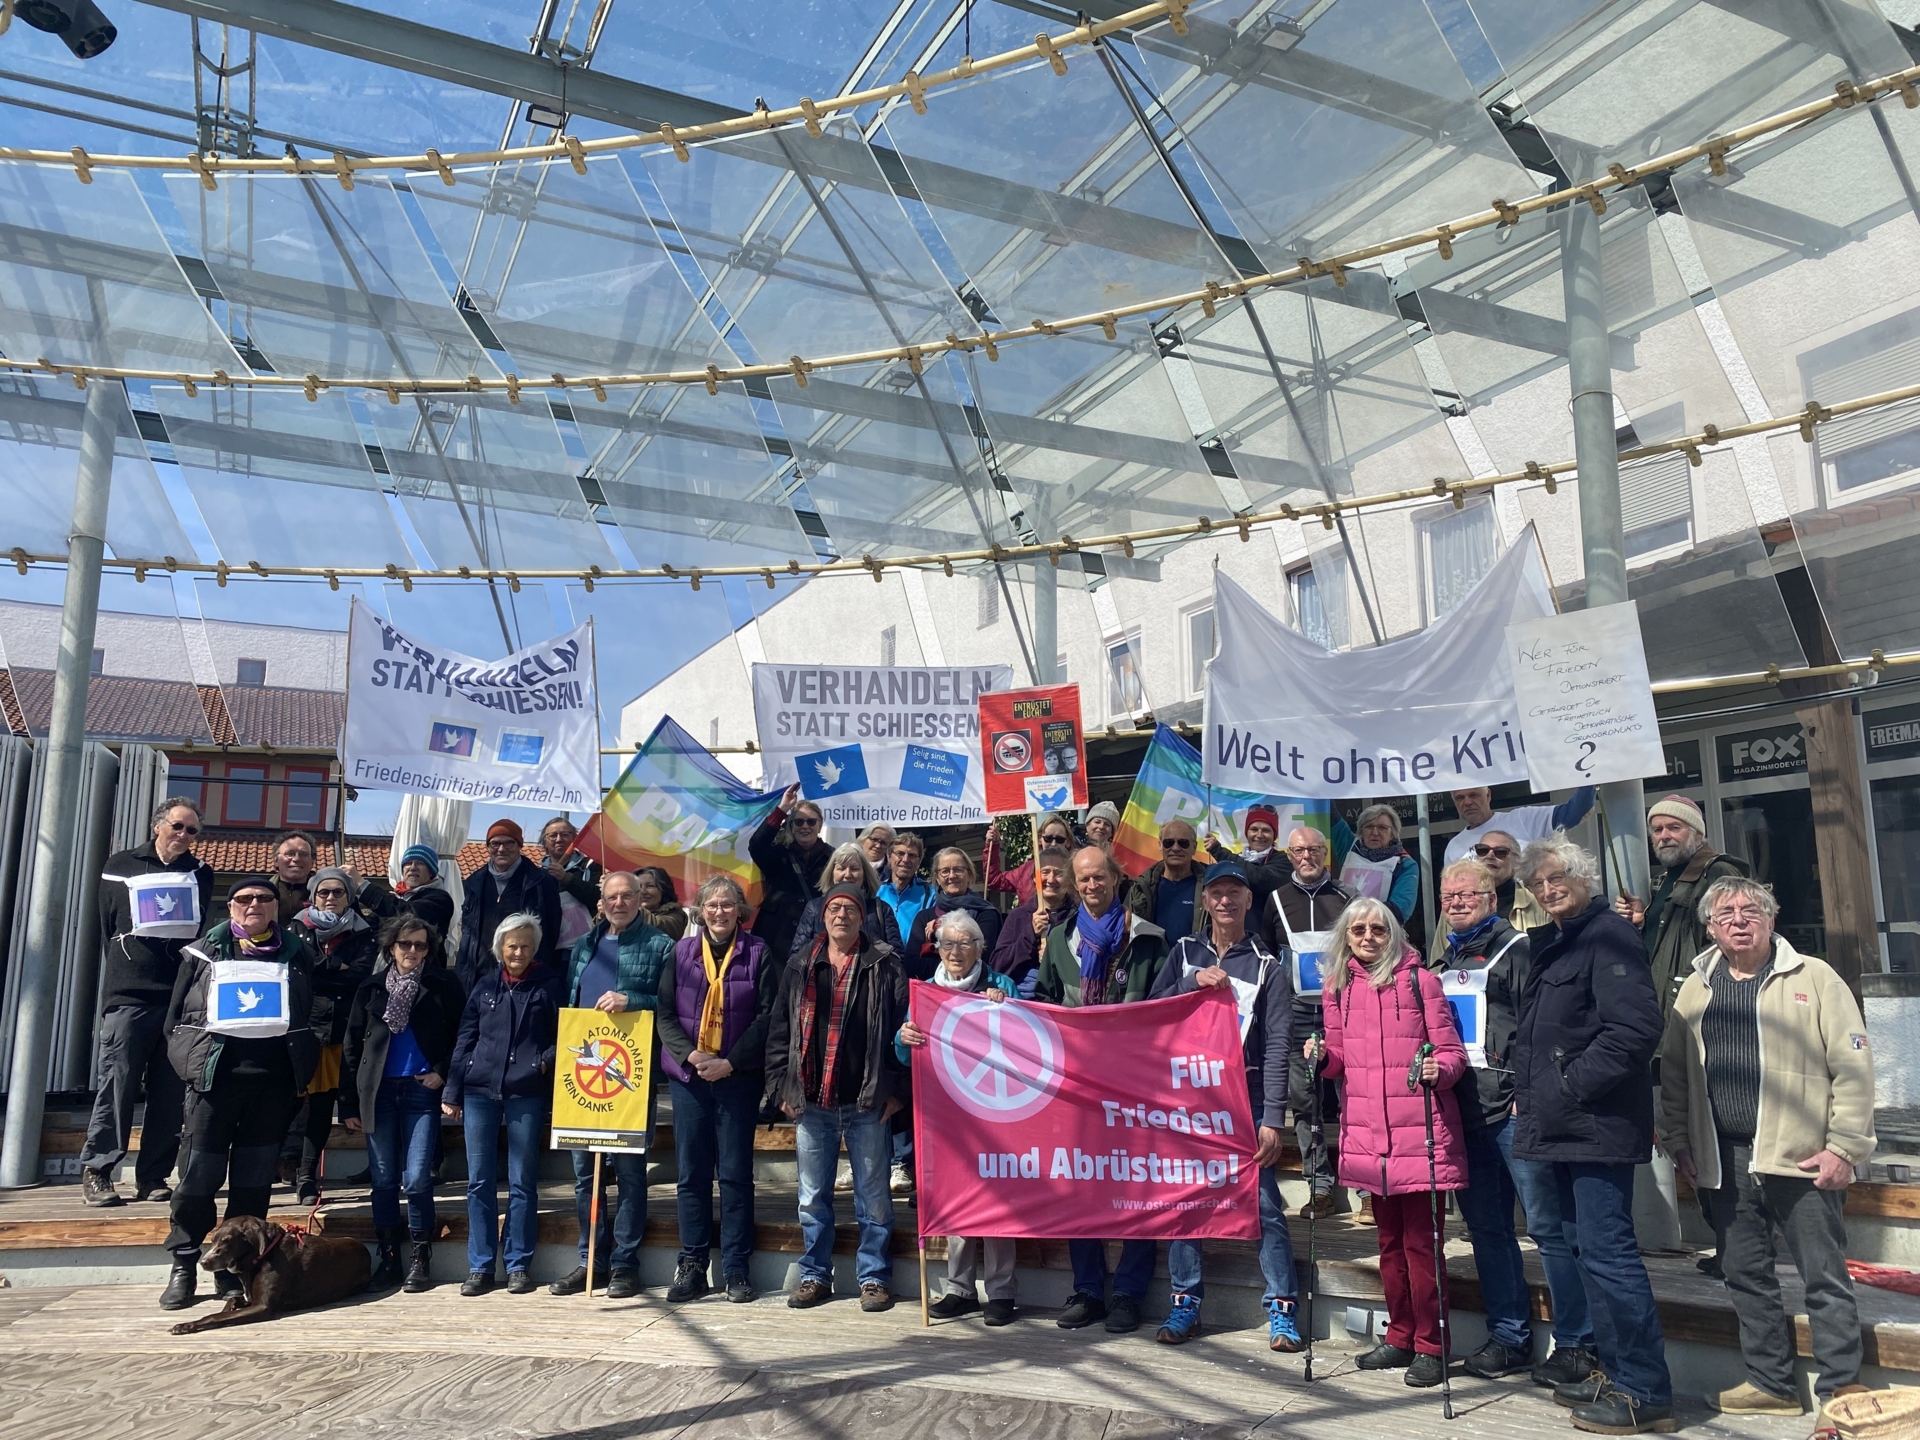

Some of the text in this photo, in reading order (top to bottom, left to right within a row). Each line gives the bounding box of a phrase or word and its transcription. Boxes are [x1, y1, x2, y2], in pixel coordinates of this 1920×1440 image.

[776, 670, 992, 705] VERHANDELN
[776, 712, 850, 738] STATT
[1870, 723, 1920, 746] FREEMA
[1218, 720, 1527, 784] Welt ohne Kri
[1574, 741, 1597, 778] ?
[1731, 733, 1802, 767] FOX
[1733, 759, 1807, 775] MAGAZINMODEVER
[354, 758, 582, 805] Friedensinitiative Rottal-Inn
[913, 760, 954, 775] die Frieden
[928, 776, 952, 787] stiften
[823, 803, 907, 823] nsinitiative
[1170, 1054, 1225, 1089] Für
[563, 1073, 614, 1112] NEIN DANKE
[1101, 1100, 1235, 1136] Frieden
[589, 1138, 602, 1146] statt
[978, 1147, 1240, 1189] und Abrüstung!
